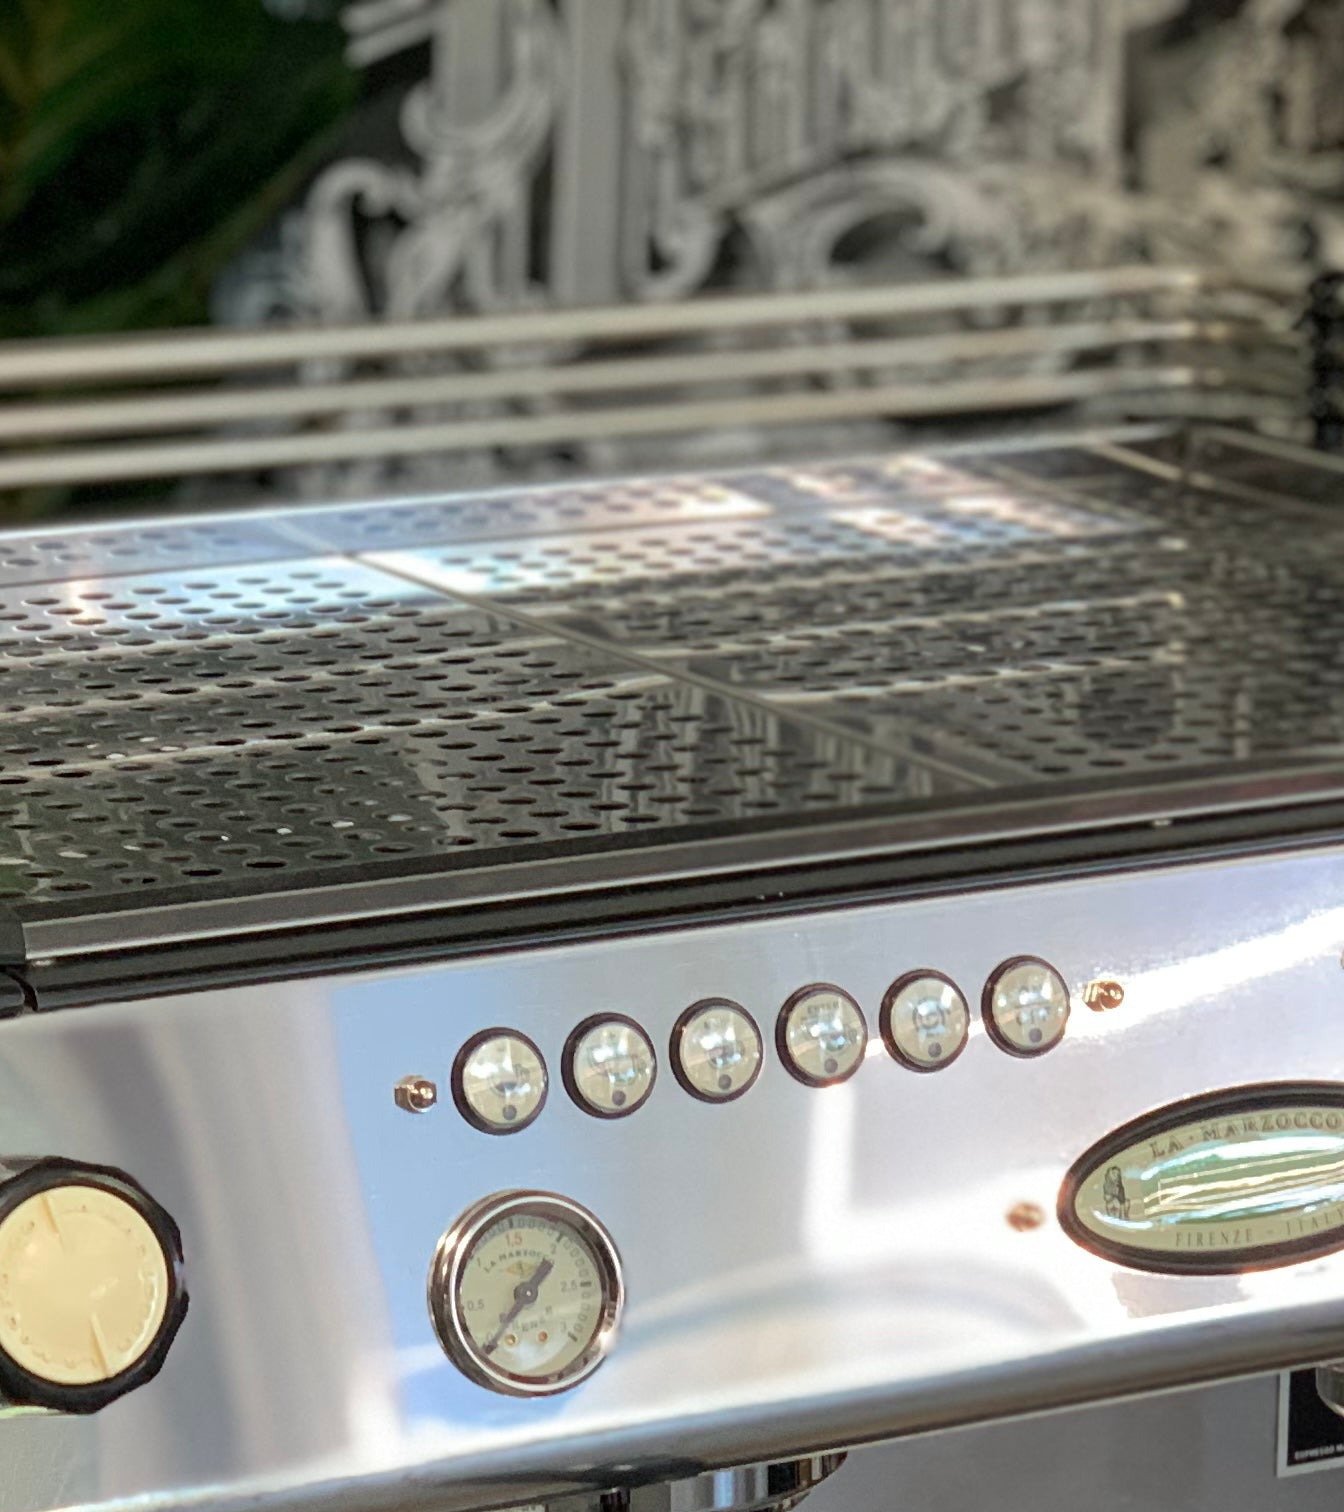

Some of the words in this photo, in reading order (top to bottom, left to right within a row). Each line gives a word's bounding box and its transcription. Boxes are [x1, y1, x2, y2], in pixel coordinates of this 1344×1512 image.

[1150, 1133, 1184, 1159] LA
[1202, 1112, 1342, 1140] MARZOCCO
[1175, 1227, 1253, 1248] FIRENZE
